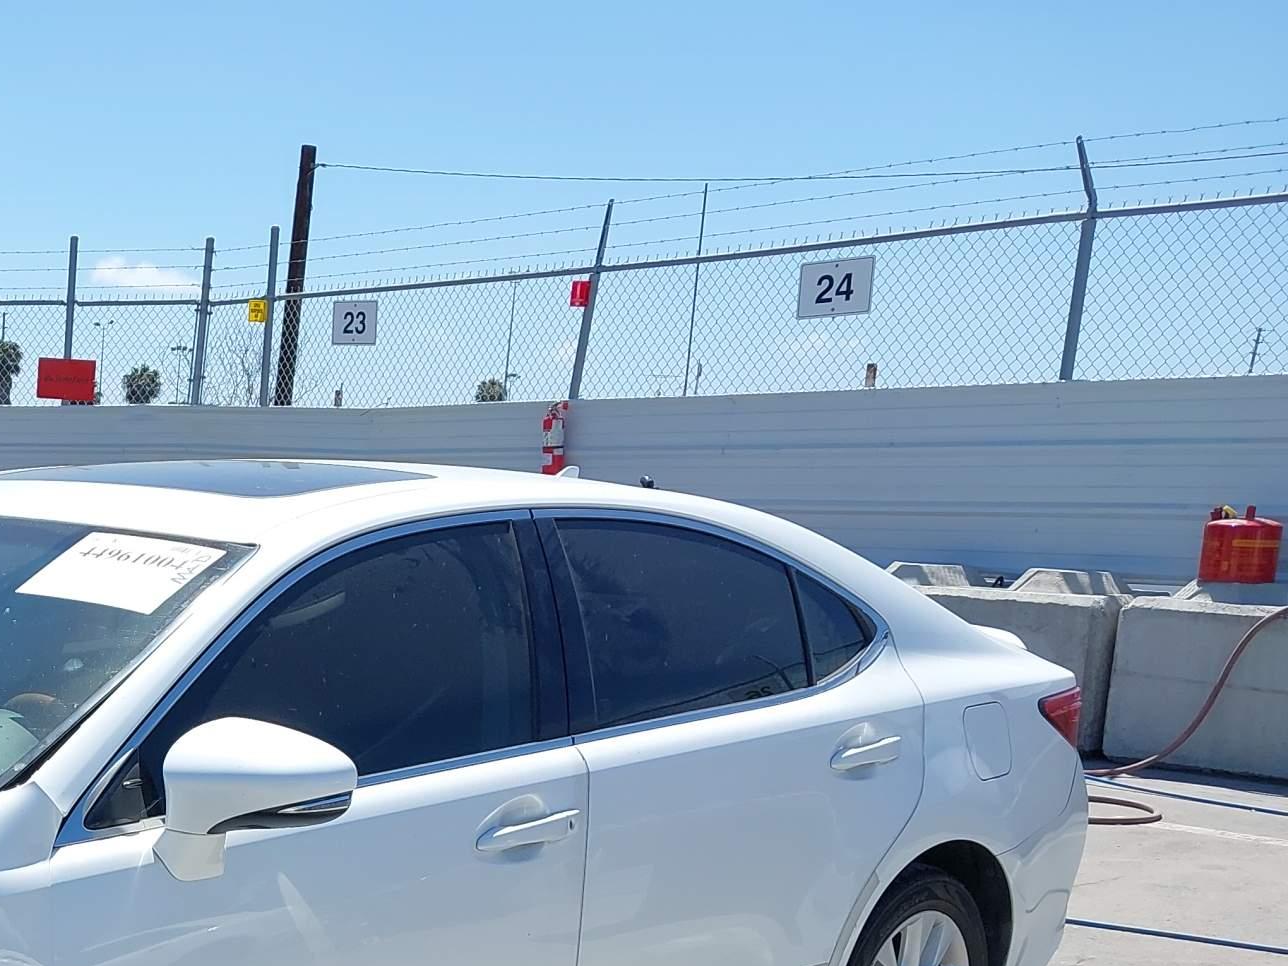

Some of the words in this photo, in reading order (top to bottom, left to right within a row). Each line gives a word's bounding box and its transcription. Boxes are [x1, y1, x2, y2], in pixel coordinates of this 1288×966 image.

[815, 272, 854, 305] 24
[342, 311, 366, 335] 23
[79, 546, 188, 570] 44961004
